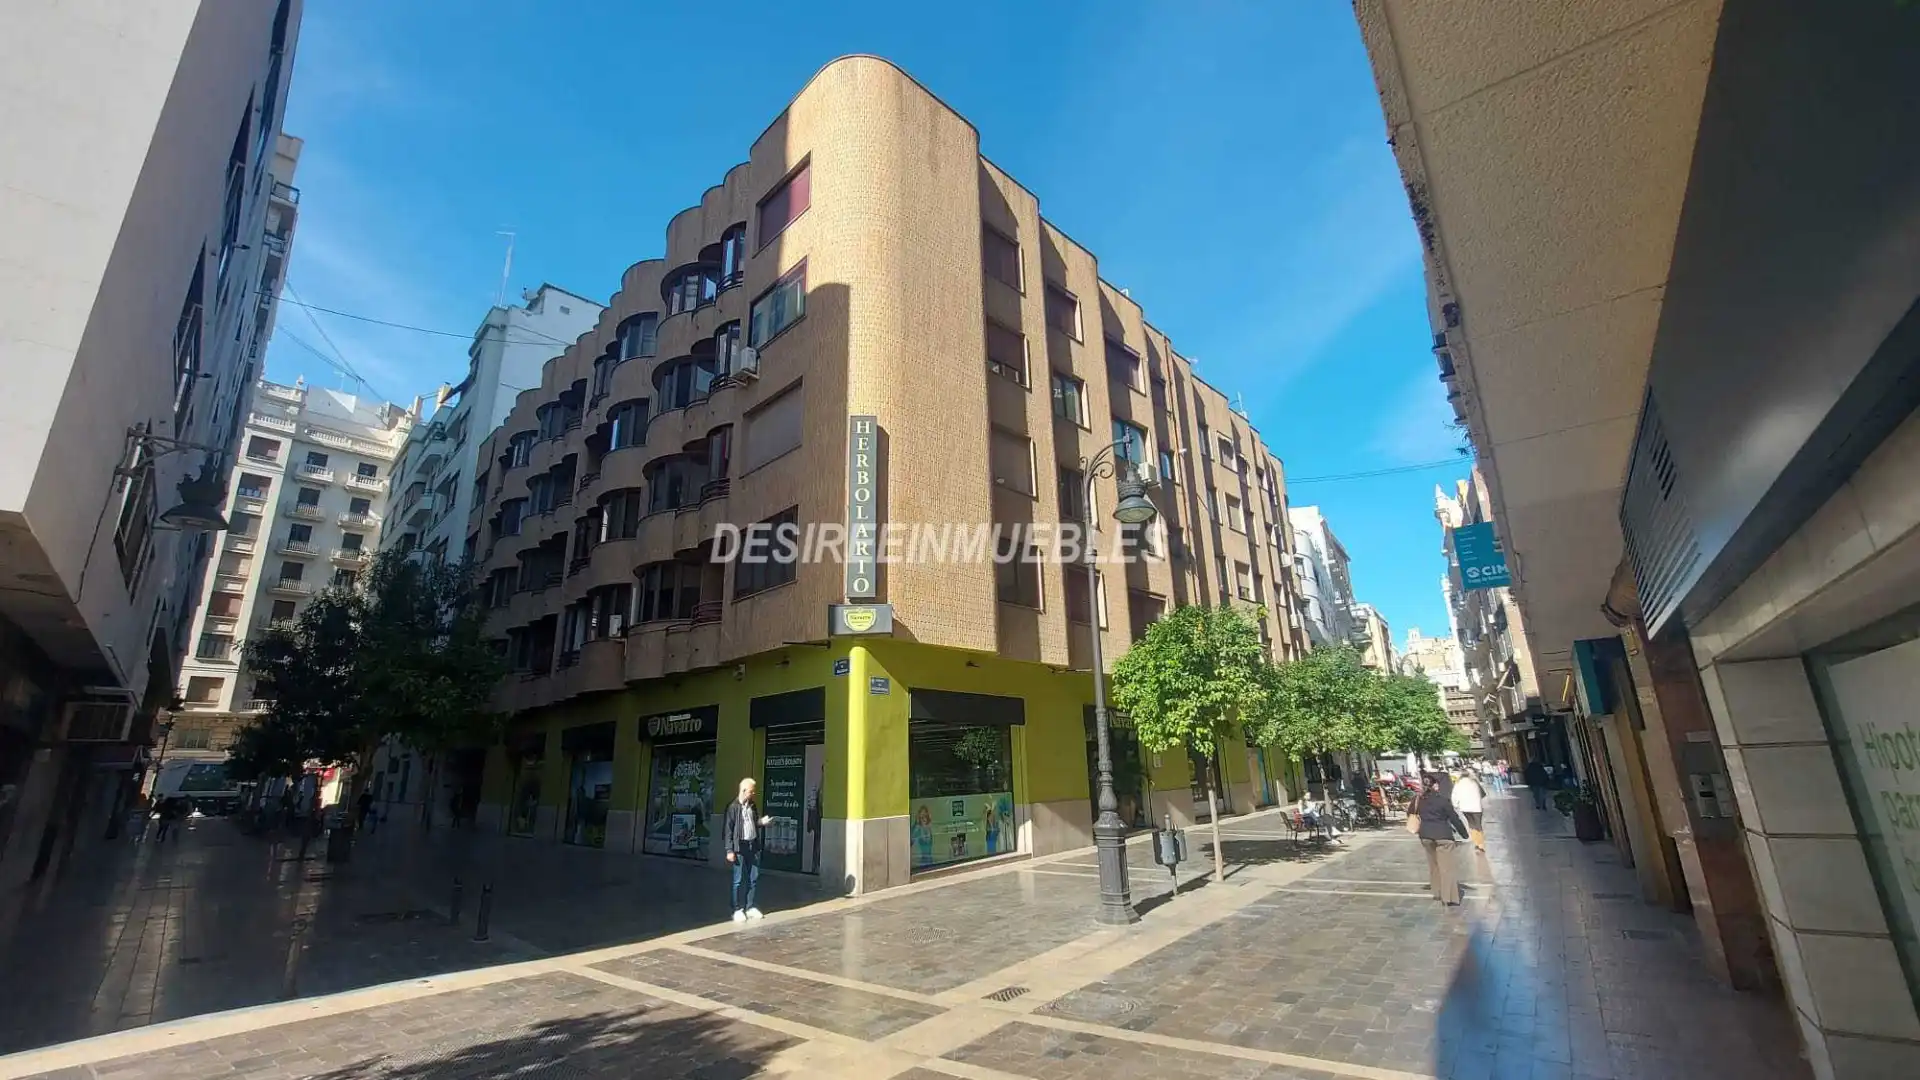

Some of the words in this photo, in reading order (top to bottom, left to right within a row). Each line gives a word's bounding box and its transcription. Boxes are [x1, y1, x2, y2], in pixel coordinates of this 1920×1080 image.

[853, 420, 871, 593] HERBOLARIO
[660, 716, 703, 736] Navarro
[1857, 722, 1920, 785] Hipot
